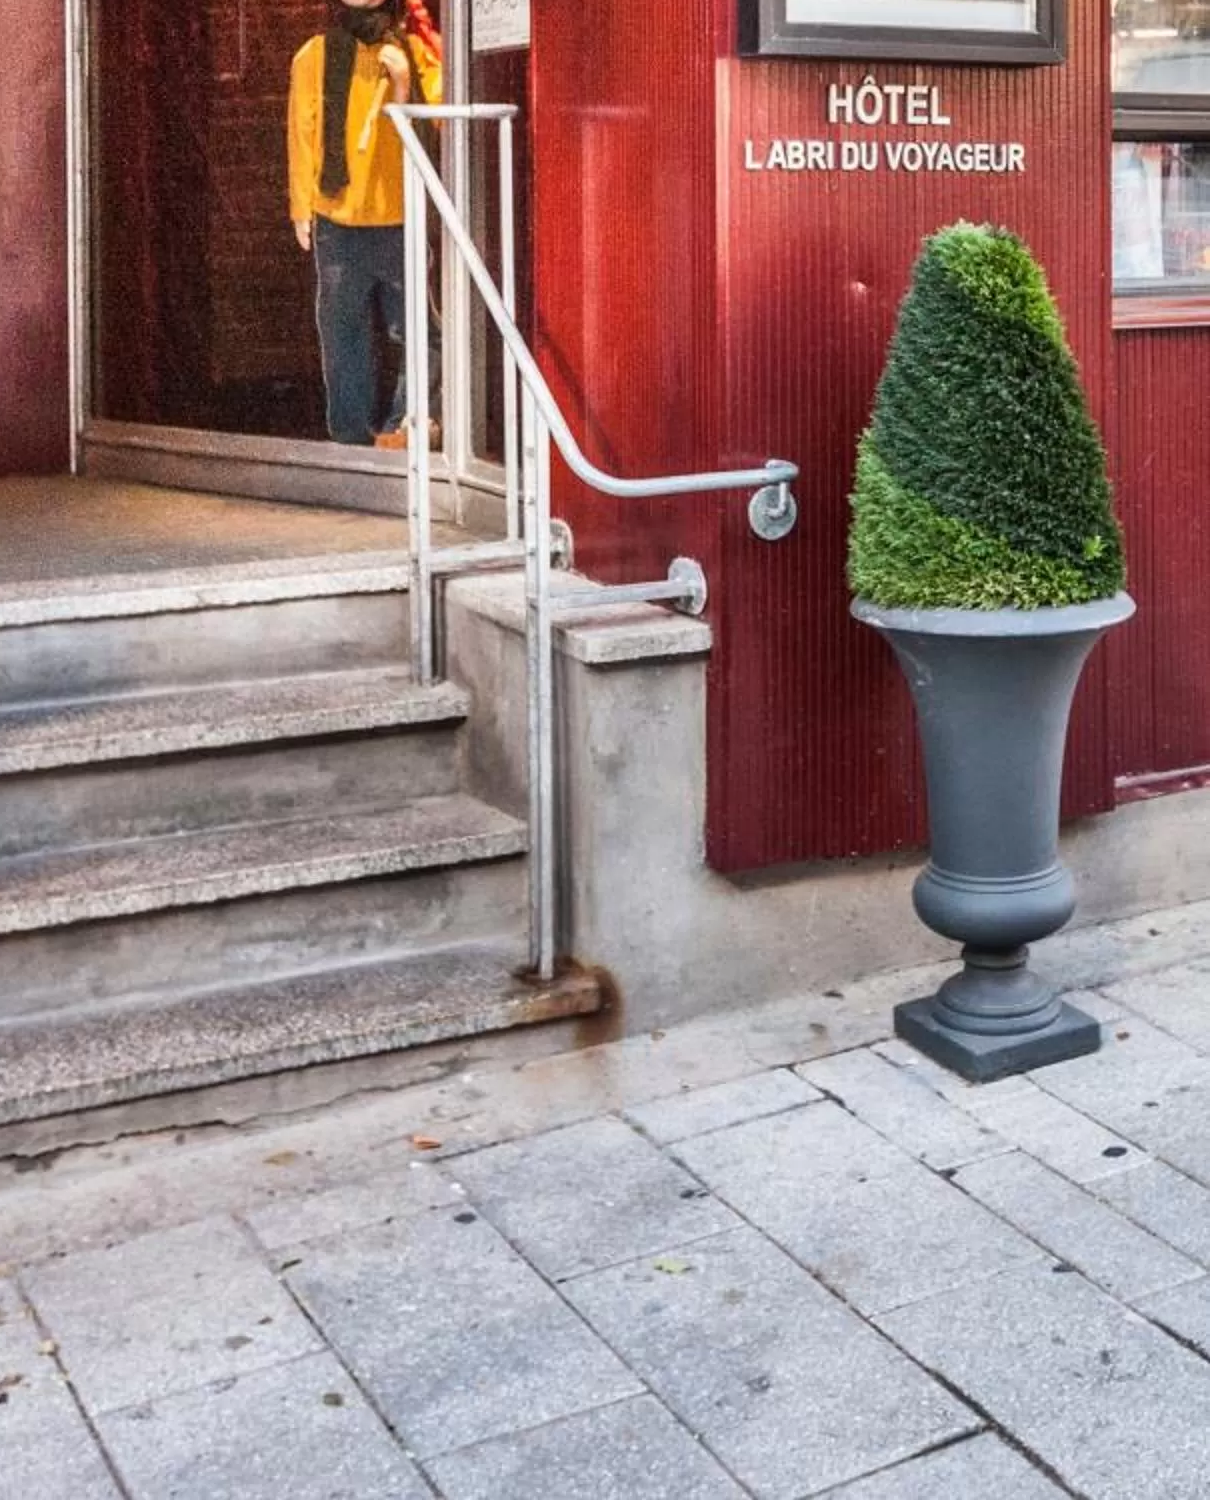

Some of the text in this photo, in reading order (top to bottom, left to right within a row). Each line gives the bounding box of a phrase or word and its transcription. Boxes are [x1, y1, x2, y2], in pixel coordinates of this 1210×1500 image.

[828, 75, 951, 125] HÔTEL
[841, 142, 878, 170] DU
[885, 142, 1026, 172] VOYAGEUR
